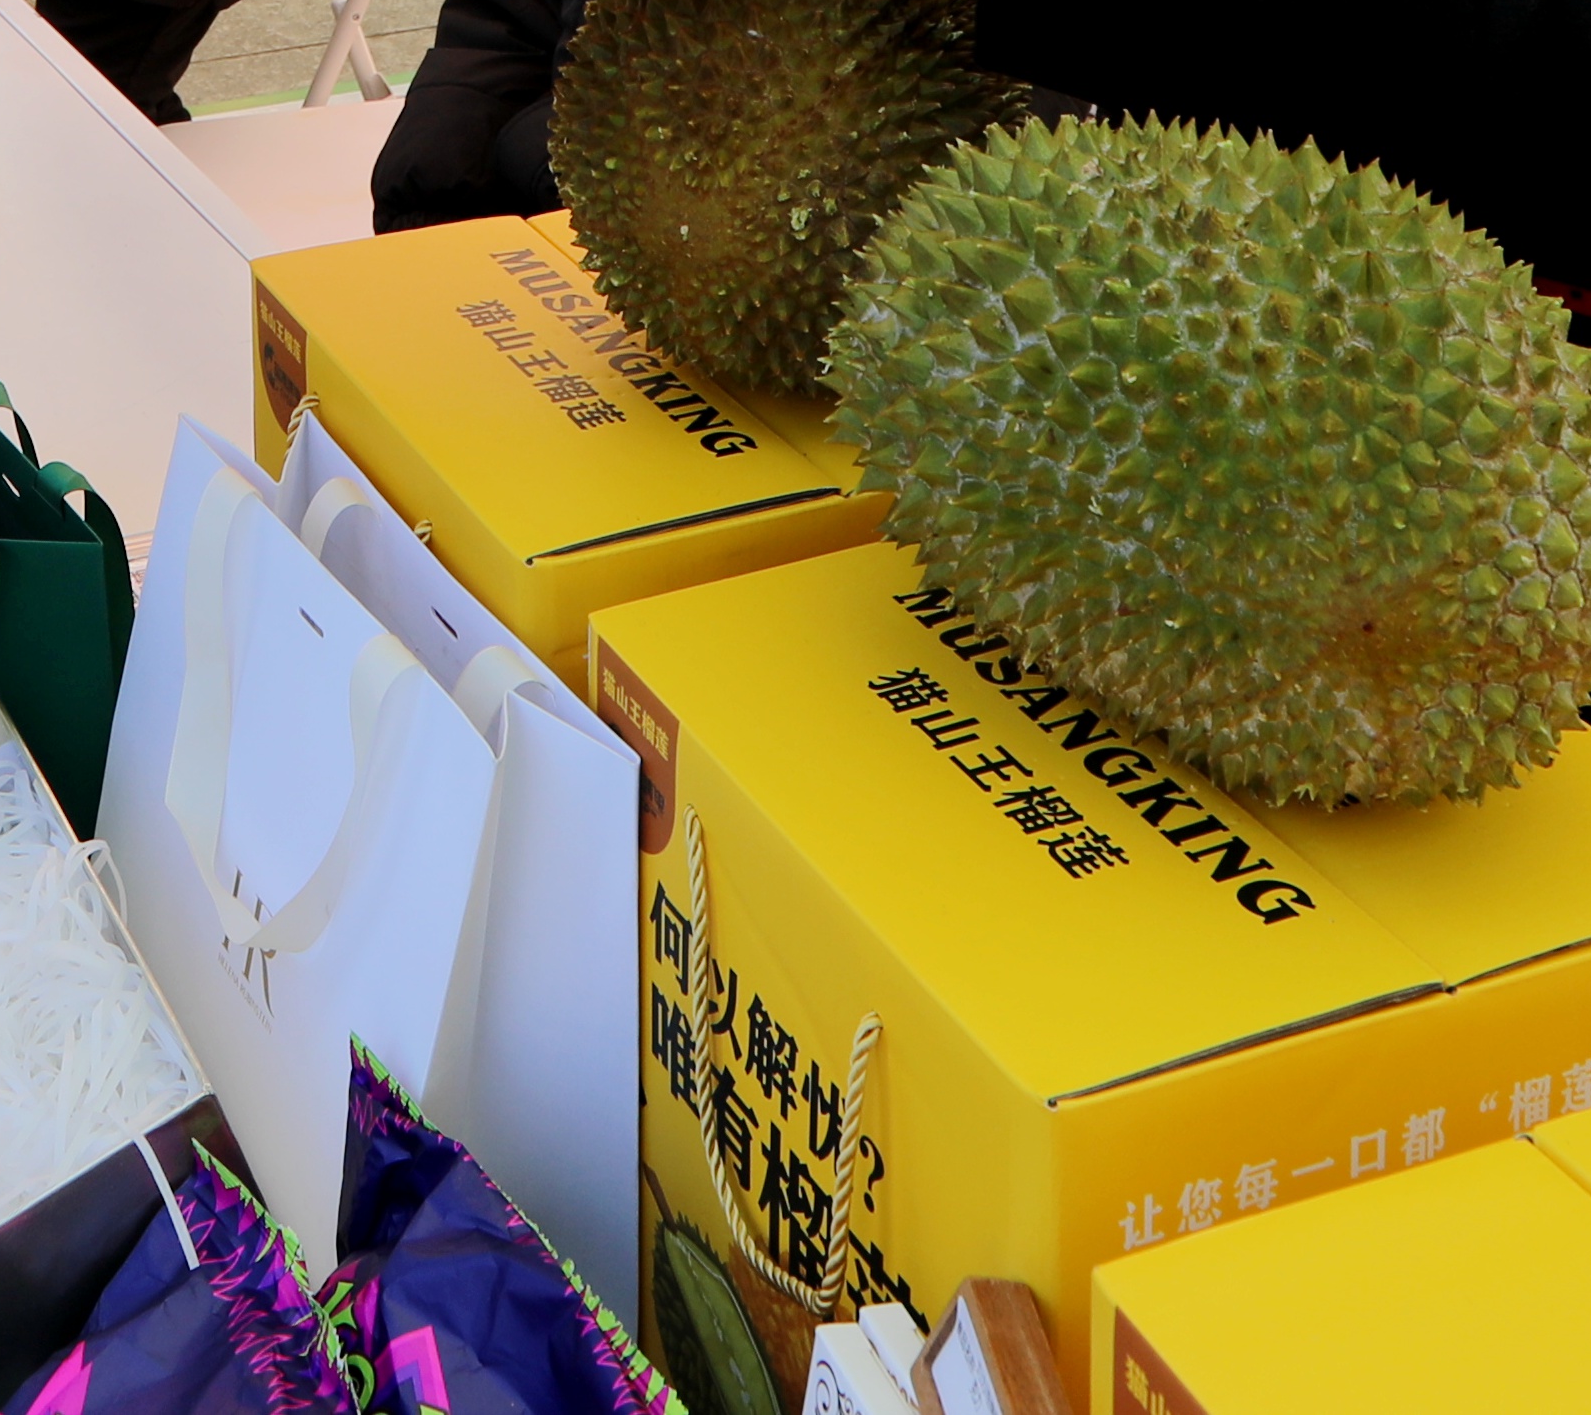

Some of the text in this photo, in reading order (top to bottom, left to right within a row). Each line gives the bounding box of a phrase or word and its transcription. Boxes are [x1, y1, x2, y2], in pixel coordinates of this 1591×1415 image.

[455, 299, 627, 431] 猫山王榴莲
[489, 247, 759, 459] MUSANGKING
[603, 666, 670, 762] 猫山王榴莲
[867, 665, 1131, 880] 猫山王榴莲
[1118, 1106, 1446, 1252] 让您每一口都
